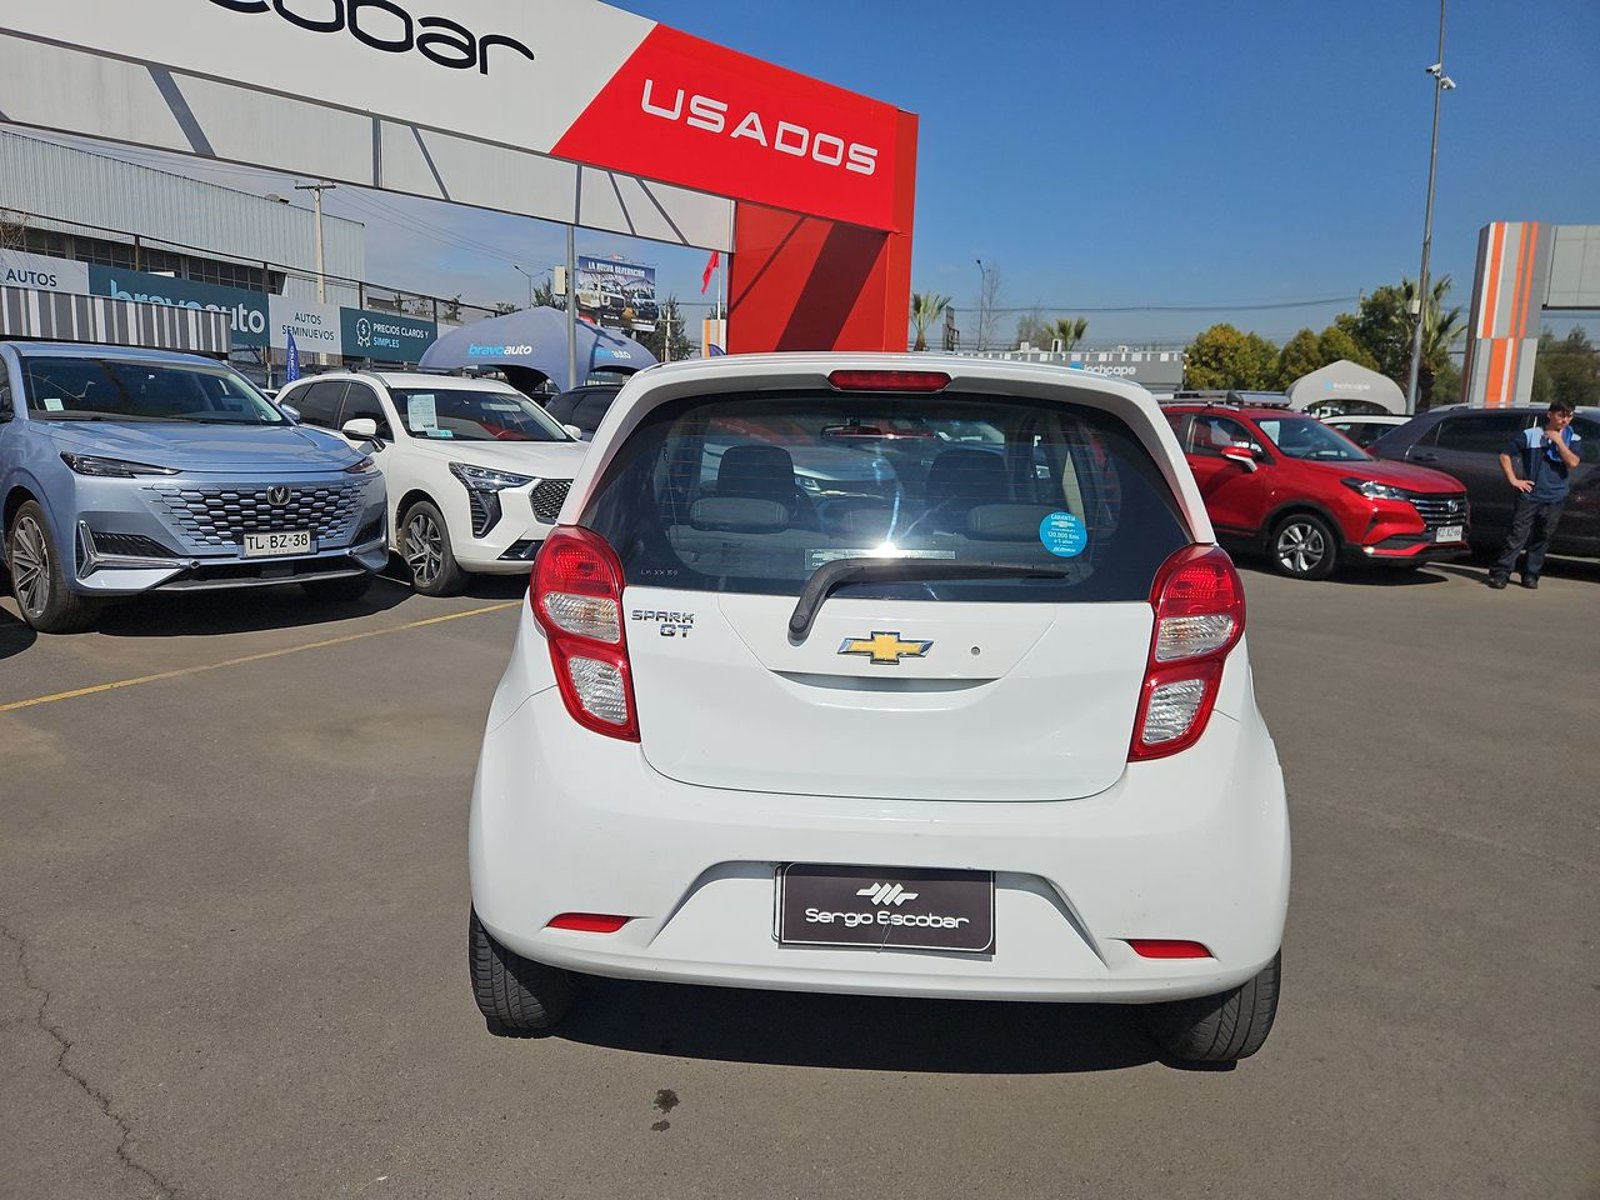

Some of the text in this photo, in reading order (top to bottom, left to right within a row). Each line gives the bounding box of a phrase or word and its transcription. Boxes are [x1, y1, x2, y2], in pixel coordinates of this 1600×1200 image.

[208, 0, 535, 75] obar
[640, 79, 878, 175] USADOS
[6, 268, 57, 287] AUTOS
[294, 312, 322, 325] AUTOS
[282, 325, 334, 341] SEMINUEVOS
[373, 323, 430, 339] PRECIOS CLAROS Y
[373, 336, 400, 349] SIMPLES
[631, 609, 695, 624] SPARK
[660, 623, 693, 638] GT
[805, 908, 970, 929] Sergio Escobar
